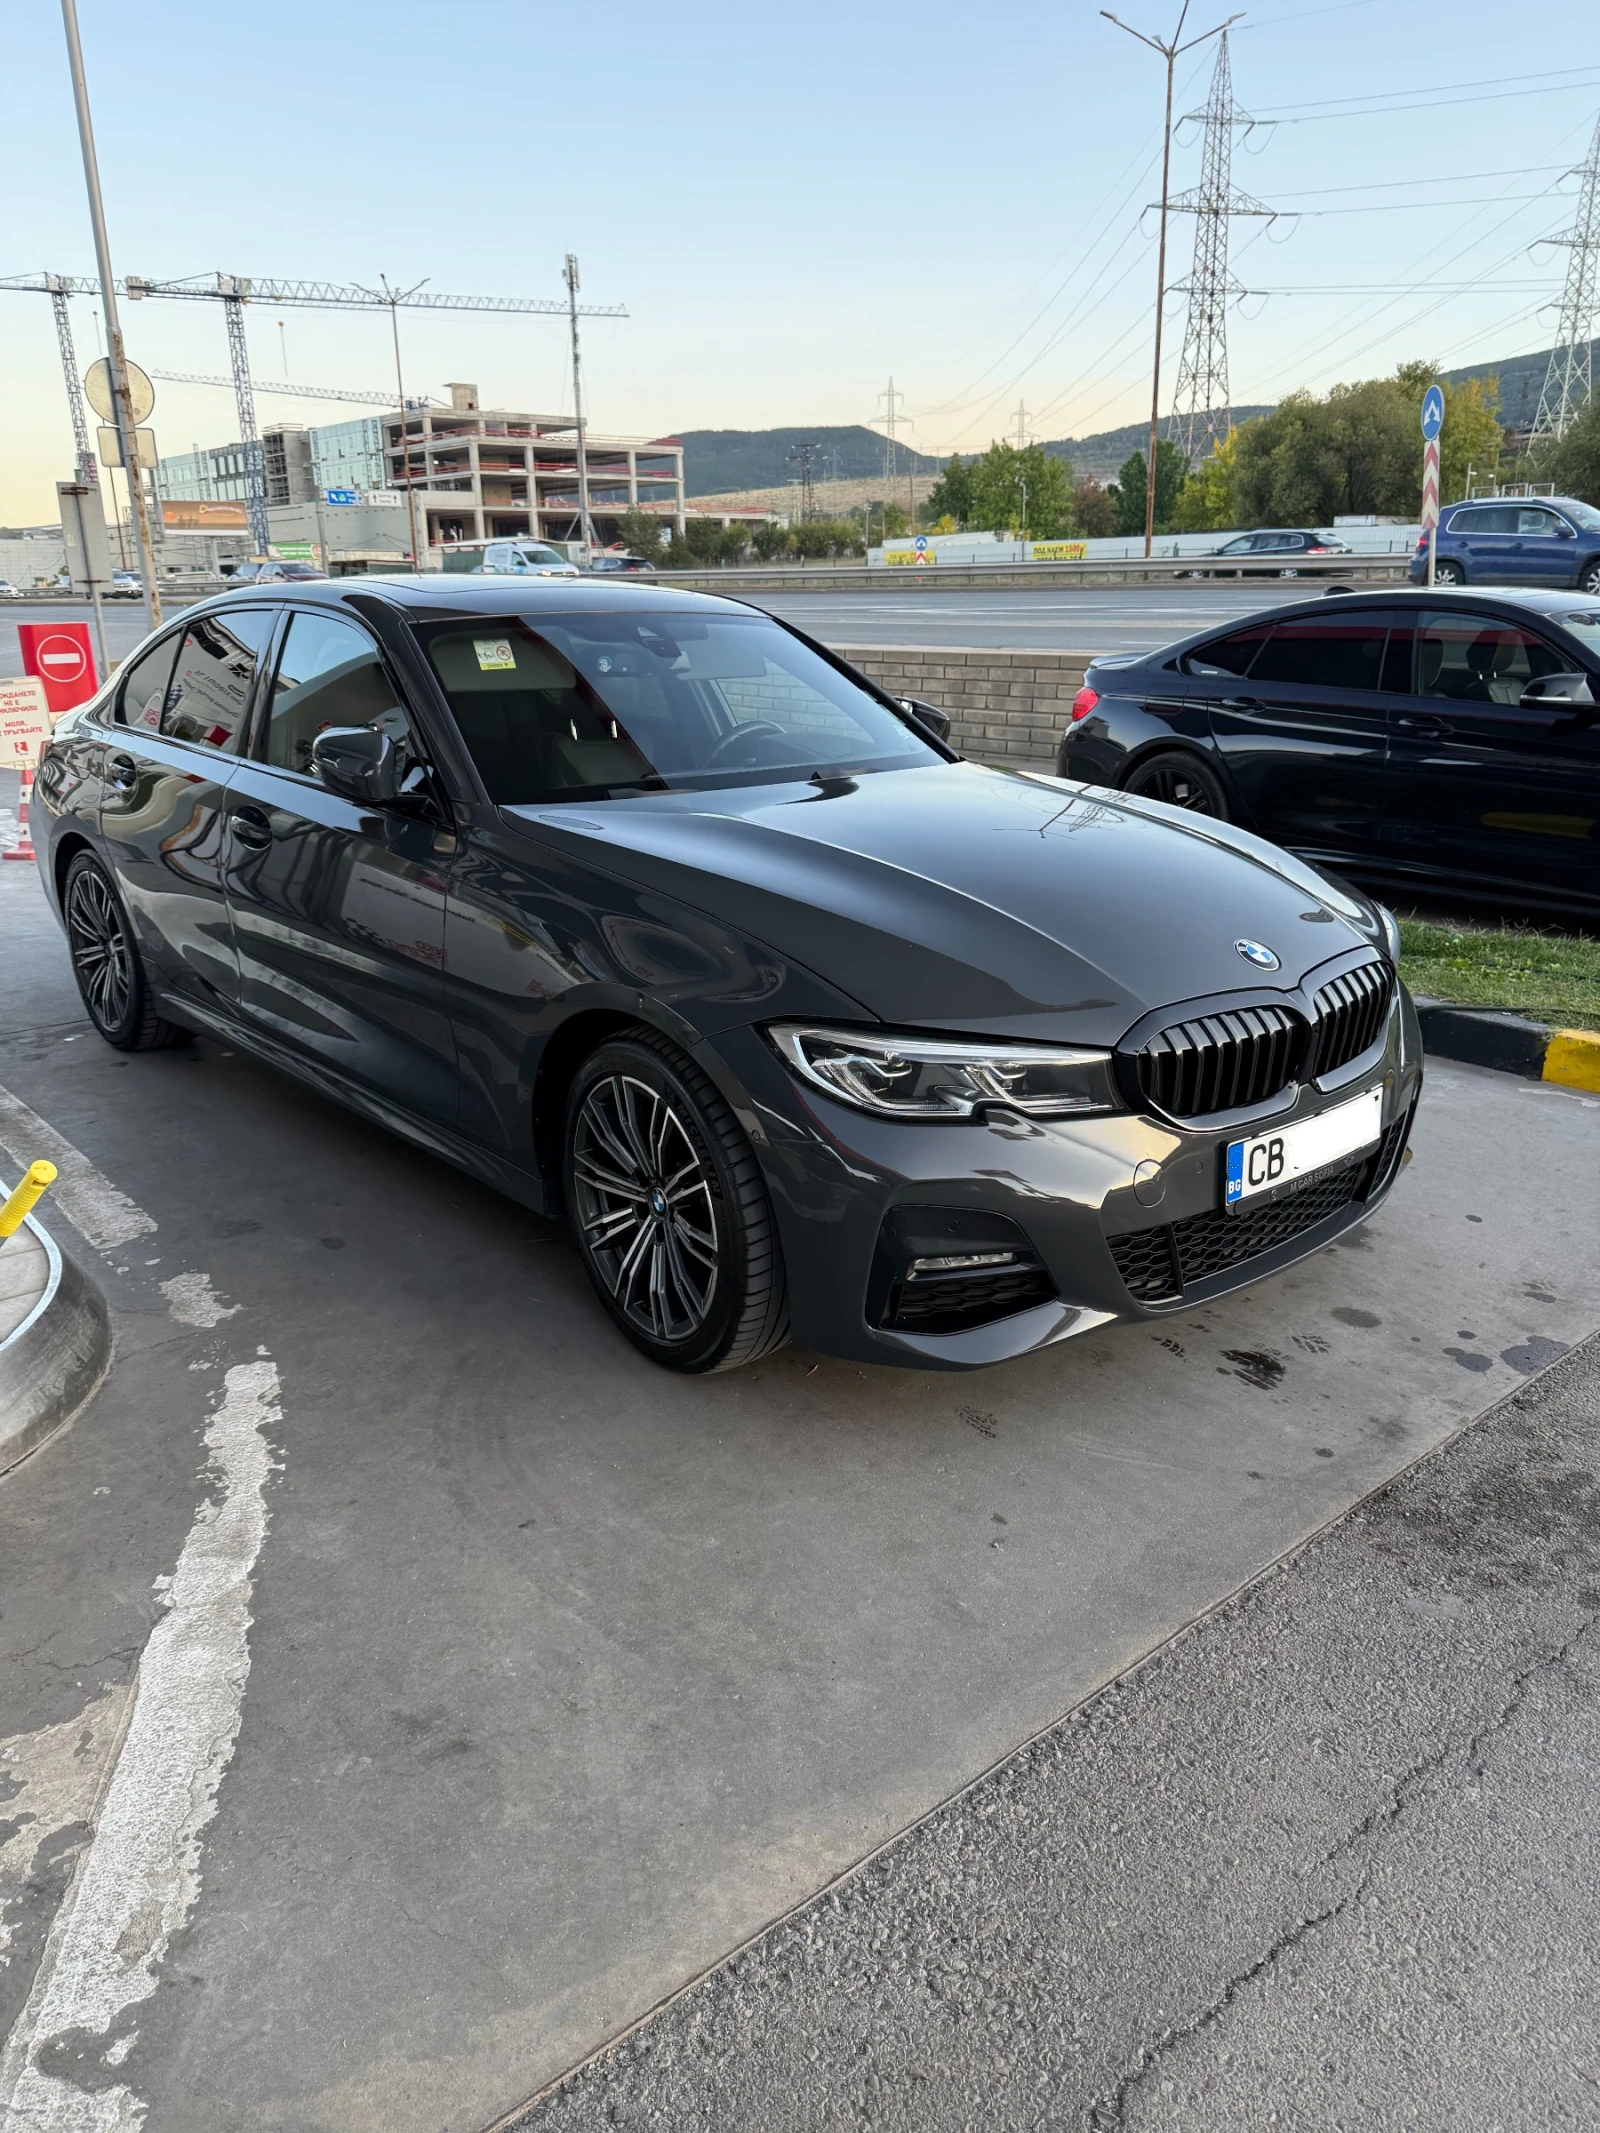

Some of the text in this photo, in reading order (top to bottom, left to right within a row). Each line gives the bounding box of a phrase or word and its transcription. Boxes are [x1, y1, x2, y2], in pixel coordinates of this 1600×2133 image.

[3, 726, 43, 736] ТРЪГВАЙТЕ
[5, 720, 28, 728] МОЛЯ,
[1248, 1137, 1284, 1187] CB
[1228, 1178, 1241, 1195] BG
[1290, 1165, 1334, 1193] M CAR SOFIA
